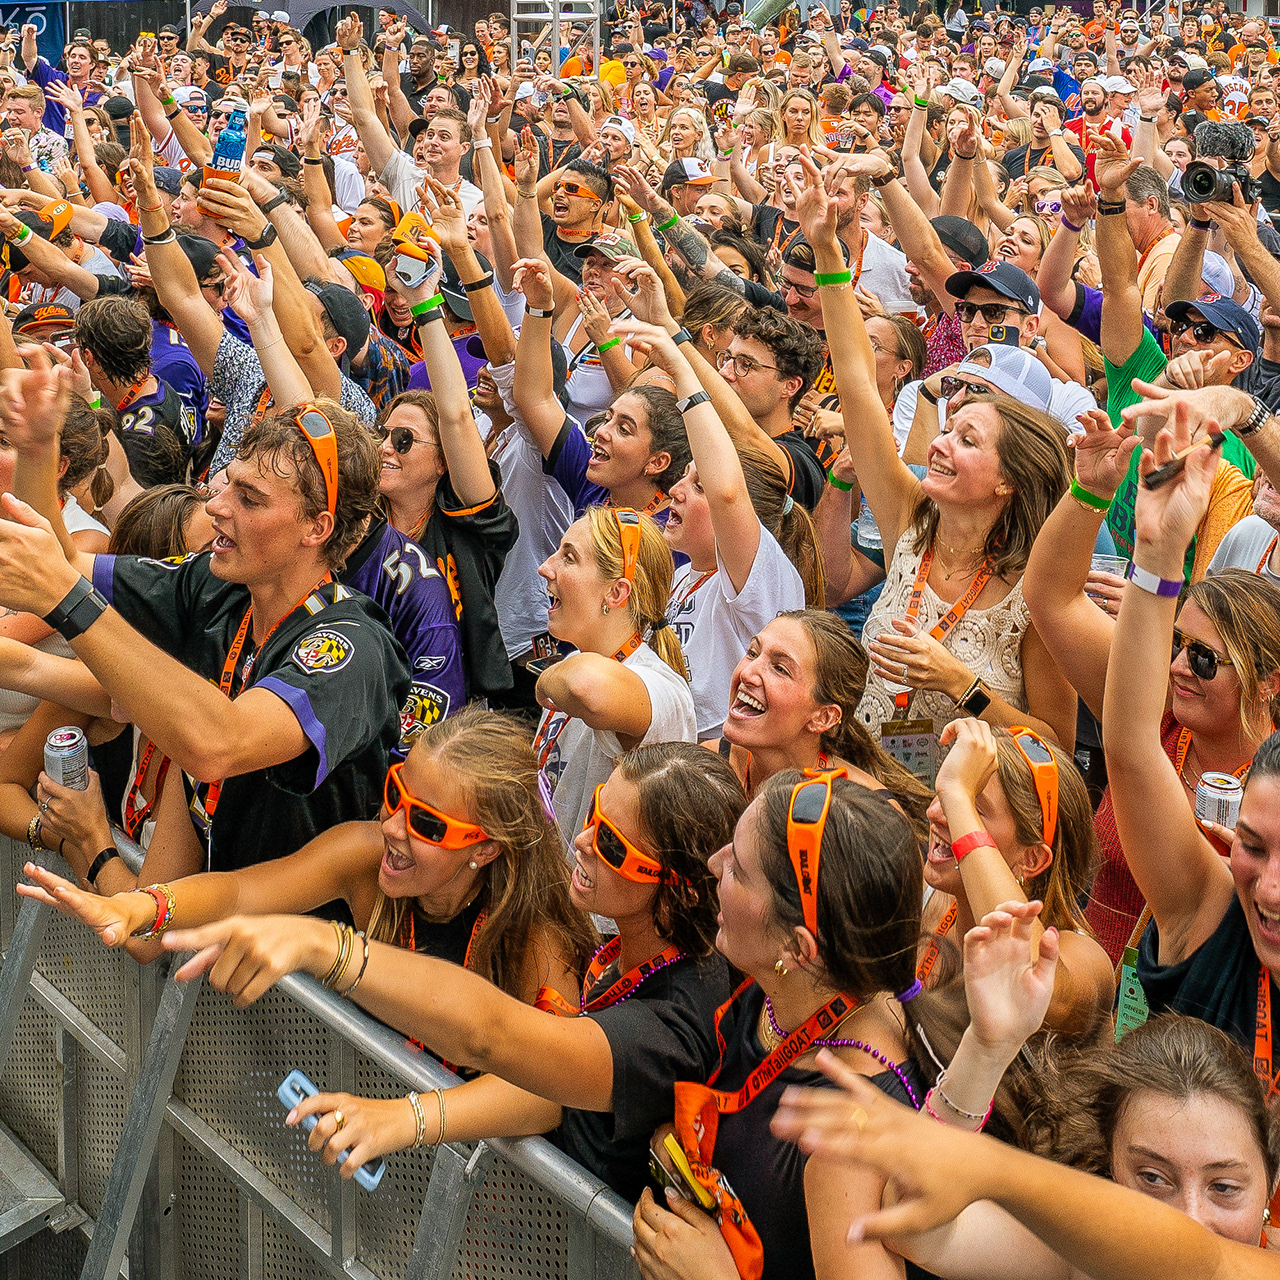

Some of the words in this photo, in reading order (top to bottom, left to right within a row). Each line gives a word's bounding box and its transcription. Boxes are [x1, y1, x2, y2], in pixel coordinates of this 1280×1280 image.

[216, 155, 240, 169] BUD
[382, 542, 442, 595] 52
[410, 685, 444, 704] AVENS
[750, 1029, 811, 1090] @TheTailGOAT
